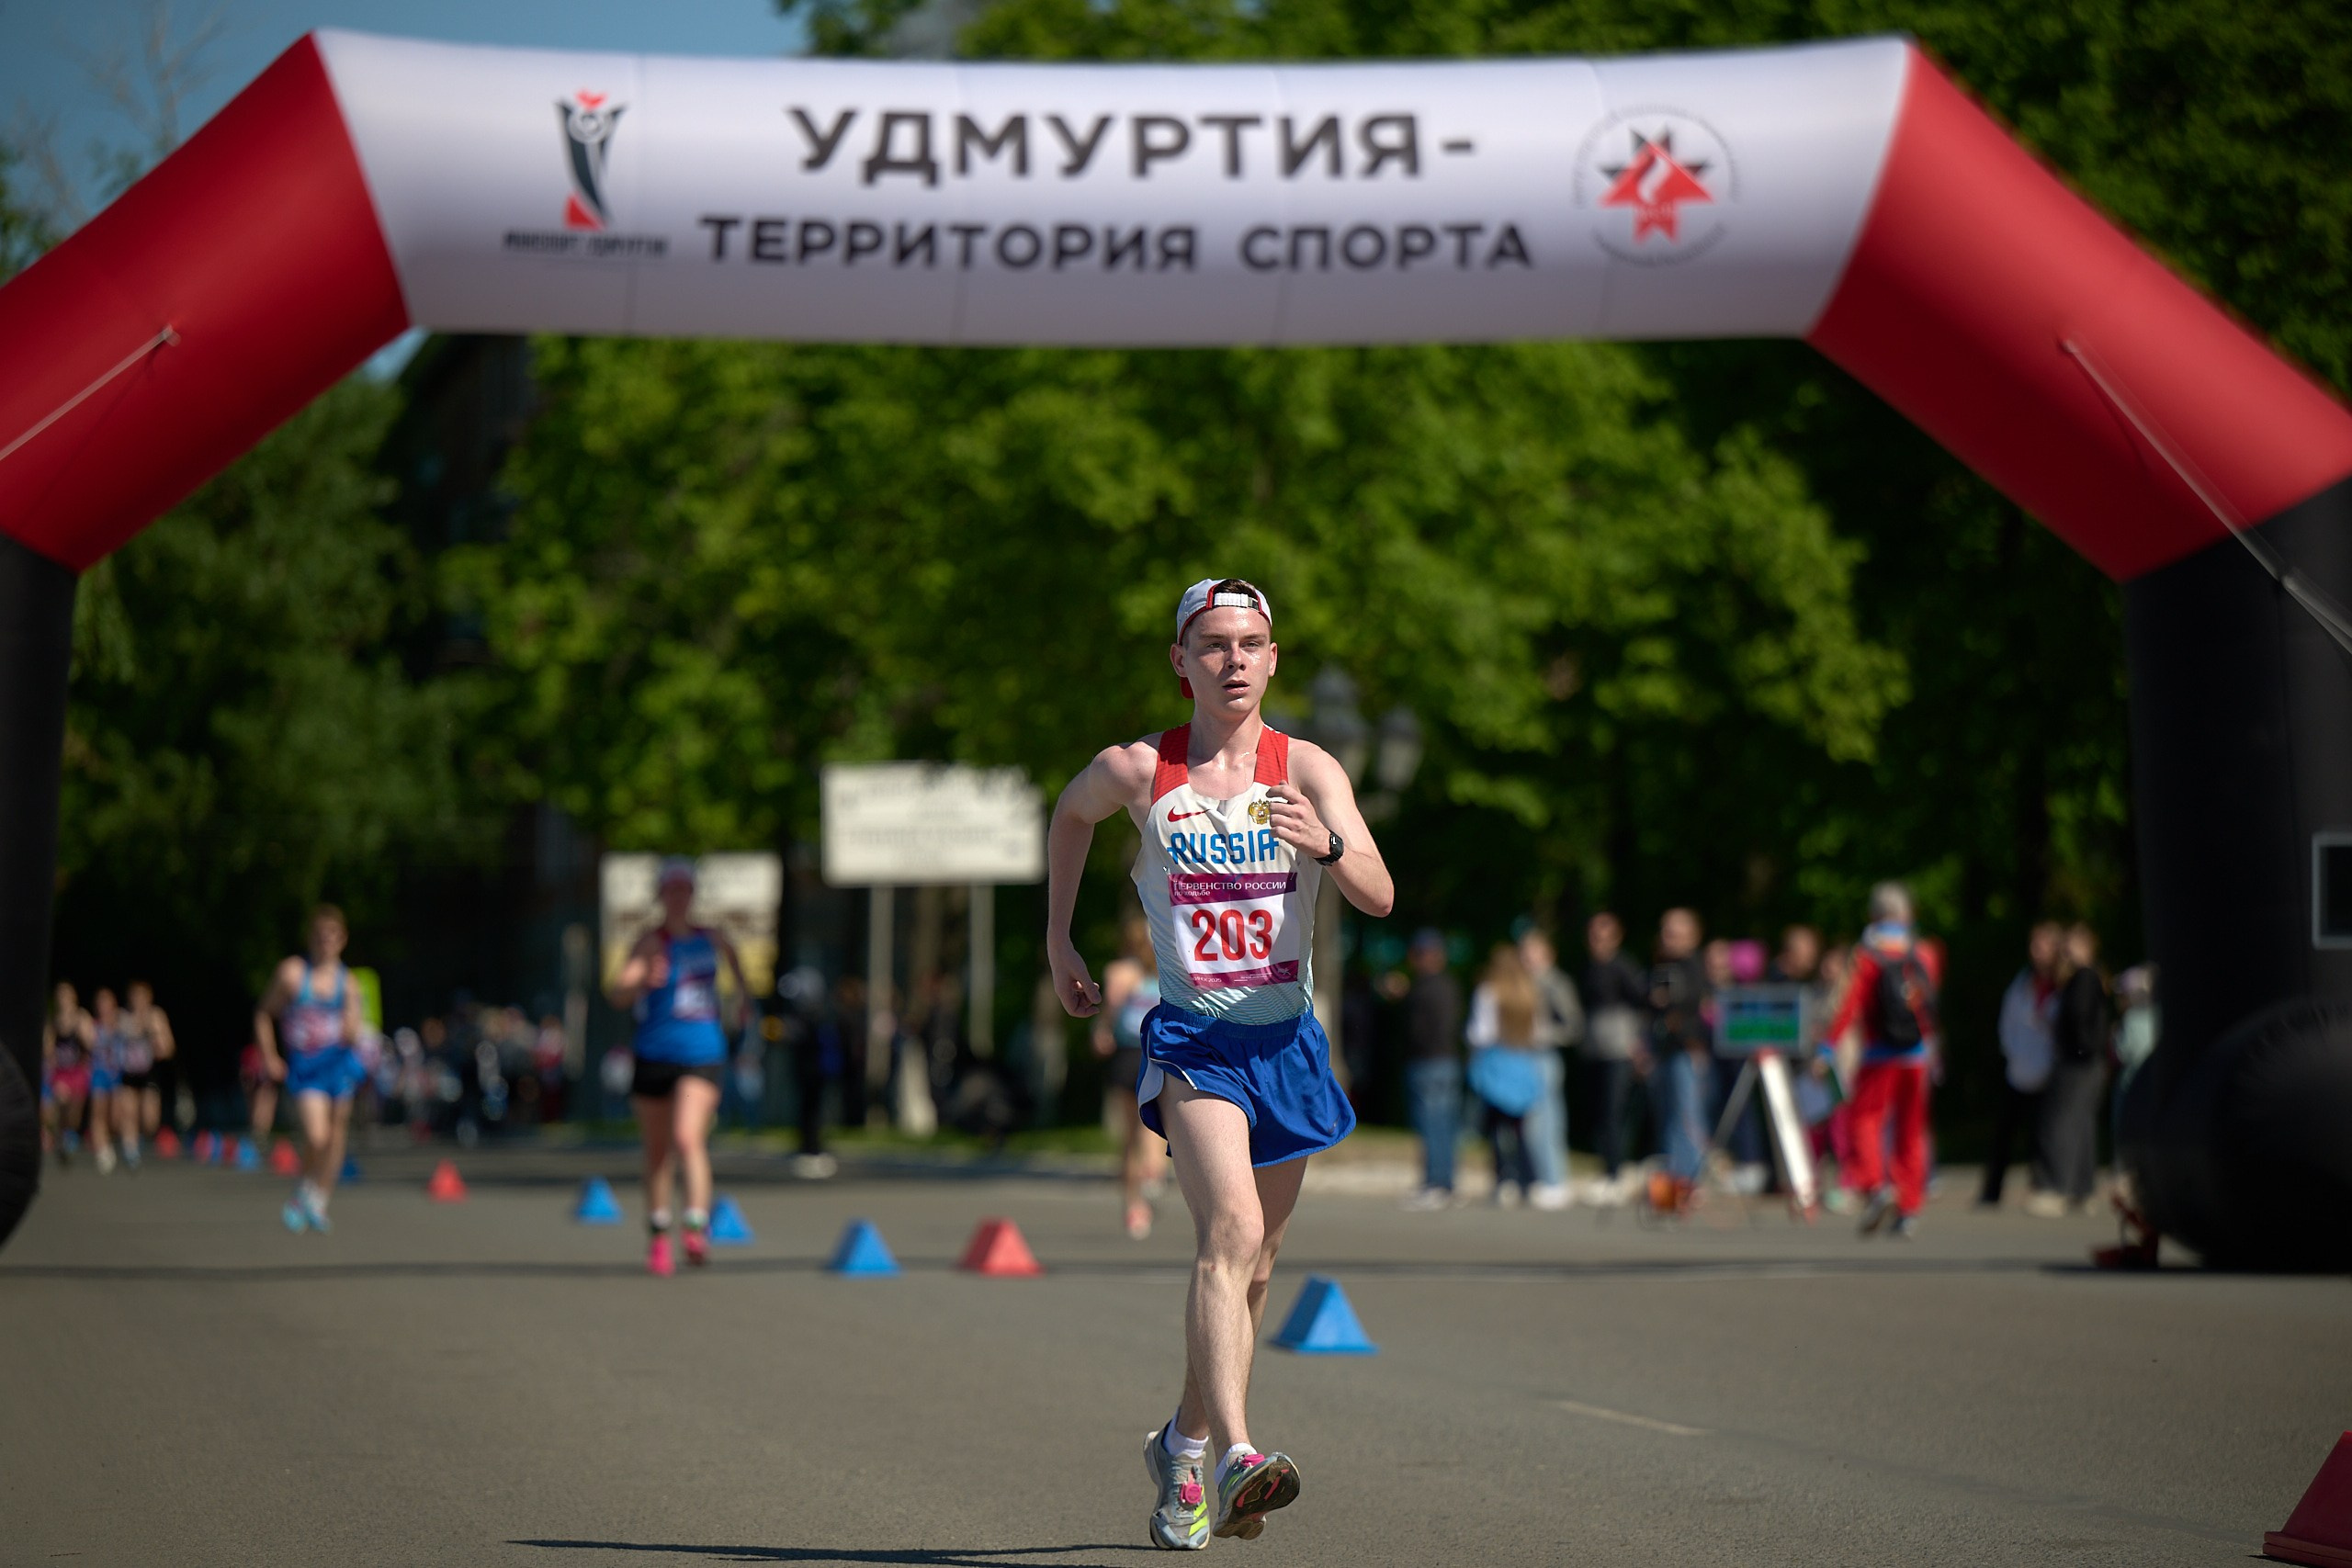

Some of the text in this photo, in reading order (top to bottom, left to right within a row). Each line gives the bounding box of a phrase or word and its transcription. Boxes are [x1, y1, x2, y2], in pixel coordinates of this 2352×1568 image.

[700, 215, 1199, 274] ТЕРРИТОРИЯ
[1238, 222, 1534, 273] СПОРТА
[1167, 829, 1279, 864] RUSSIA
[1245, 881, 1286, 890] РОССИИ
[1192, 908, 1272, 961] 203
